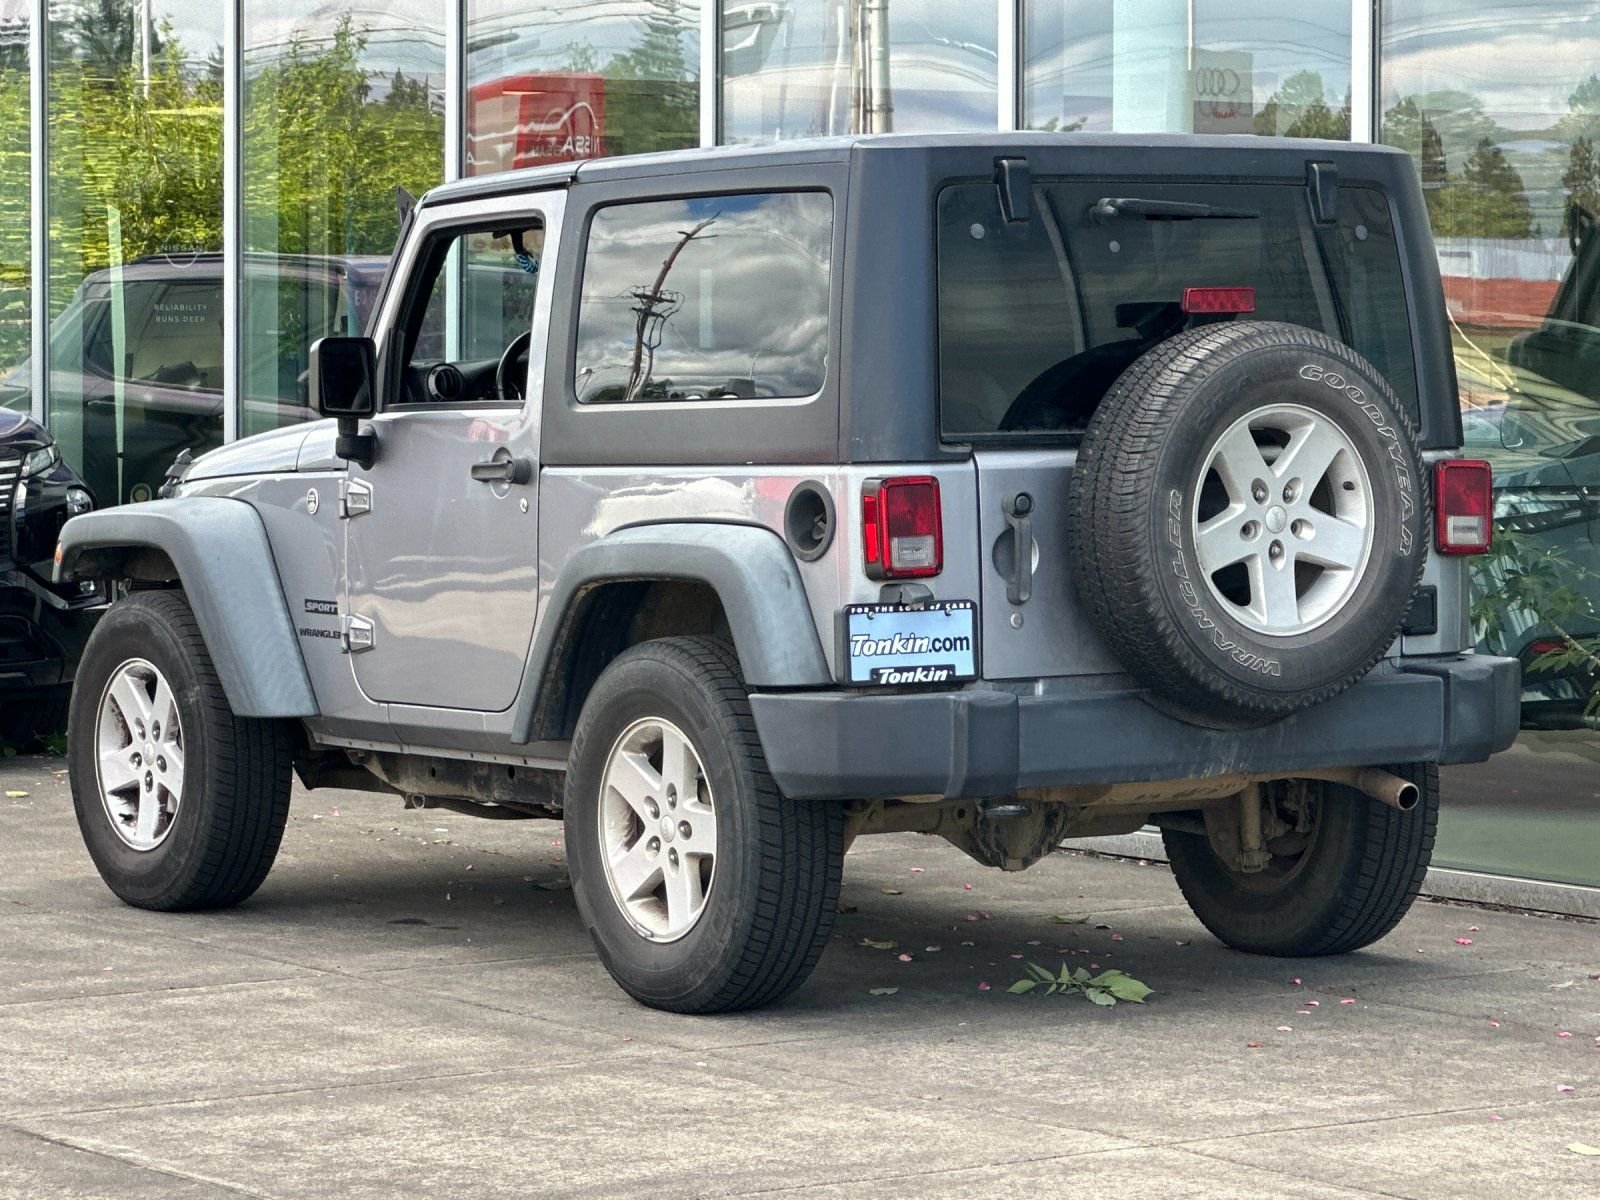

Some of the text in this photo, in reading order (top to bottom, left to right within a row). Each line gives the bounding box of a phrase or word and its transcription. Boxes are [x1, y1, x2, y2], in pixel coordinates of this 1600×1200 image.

[160, 244, 204, 252] NISSAN
[153, 303, 208, 312] RELIABILITY
[155, 314, 206, 323] RUNS DEEP
[1299, 364, 1415, 557] GOODYEAR
[1168, 488, 1282, 678] WRANGLER
[306, 601, 338, 613] SPORT
[874, 604, 894, 613] THE
[851, 632, 970, 657] Tonkin.com
[878, 667, 948, 685] Tonkin
